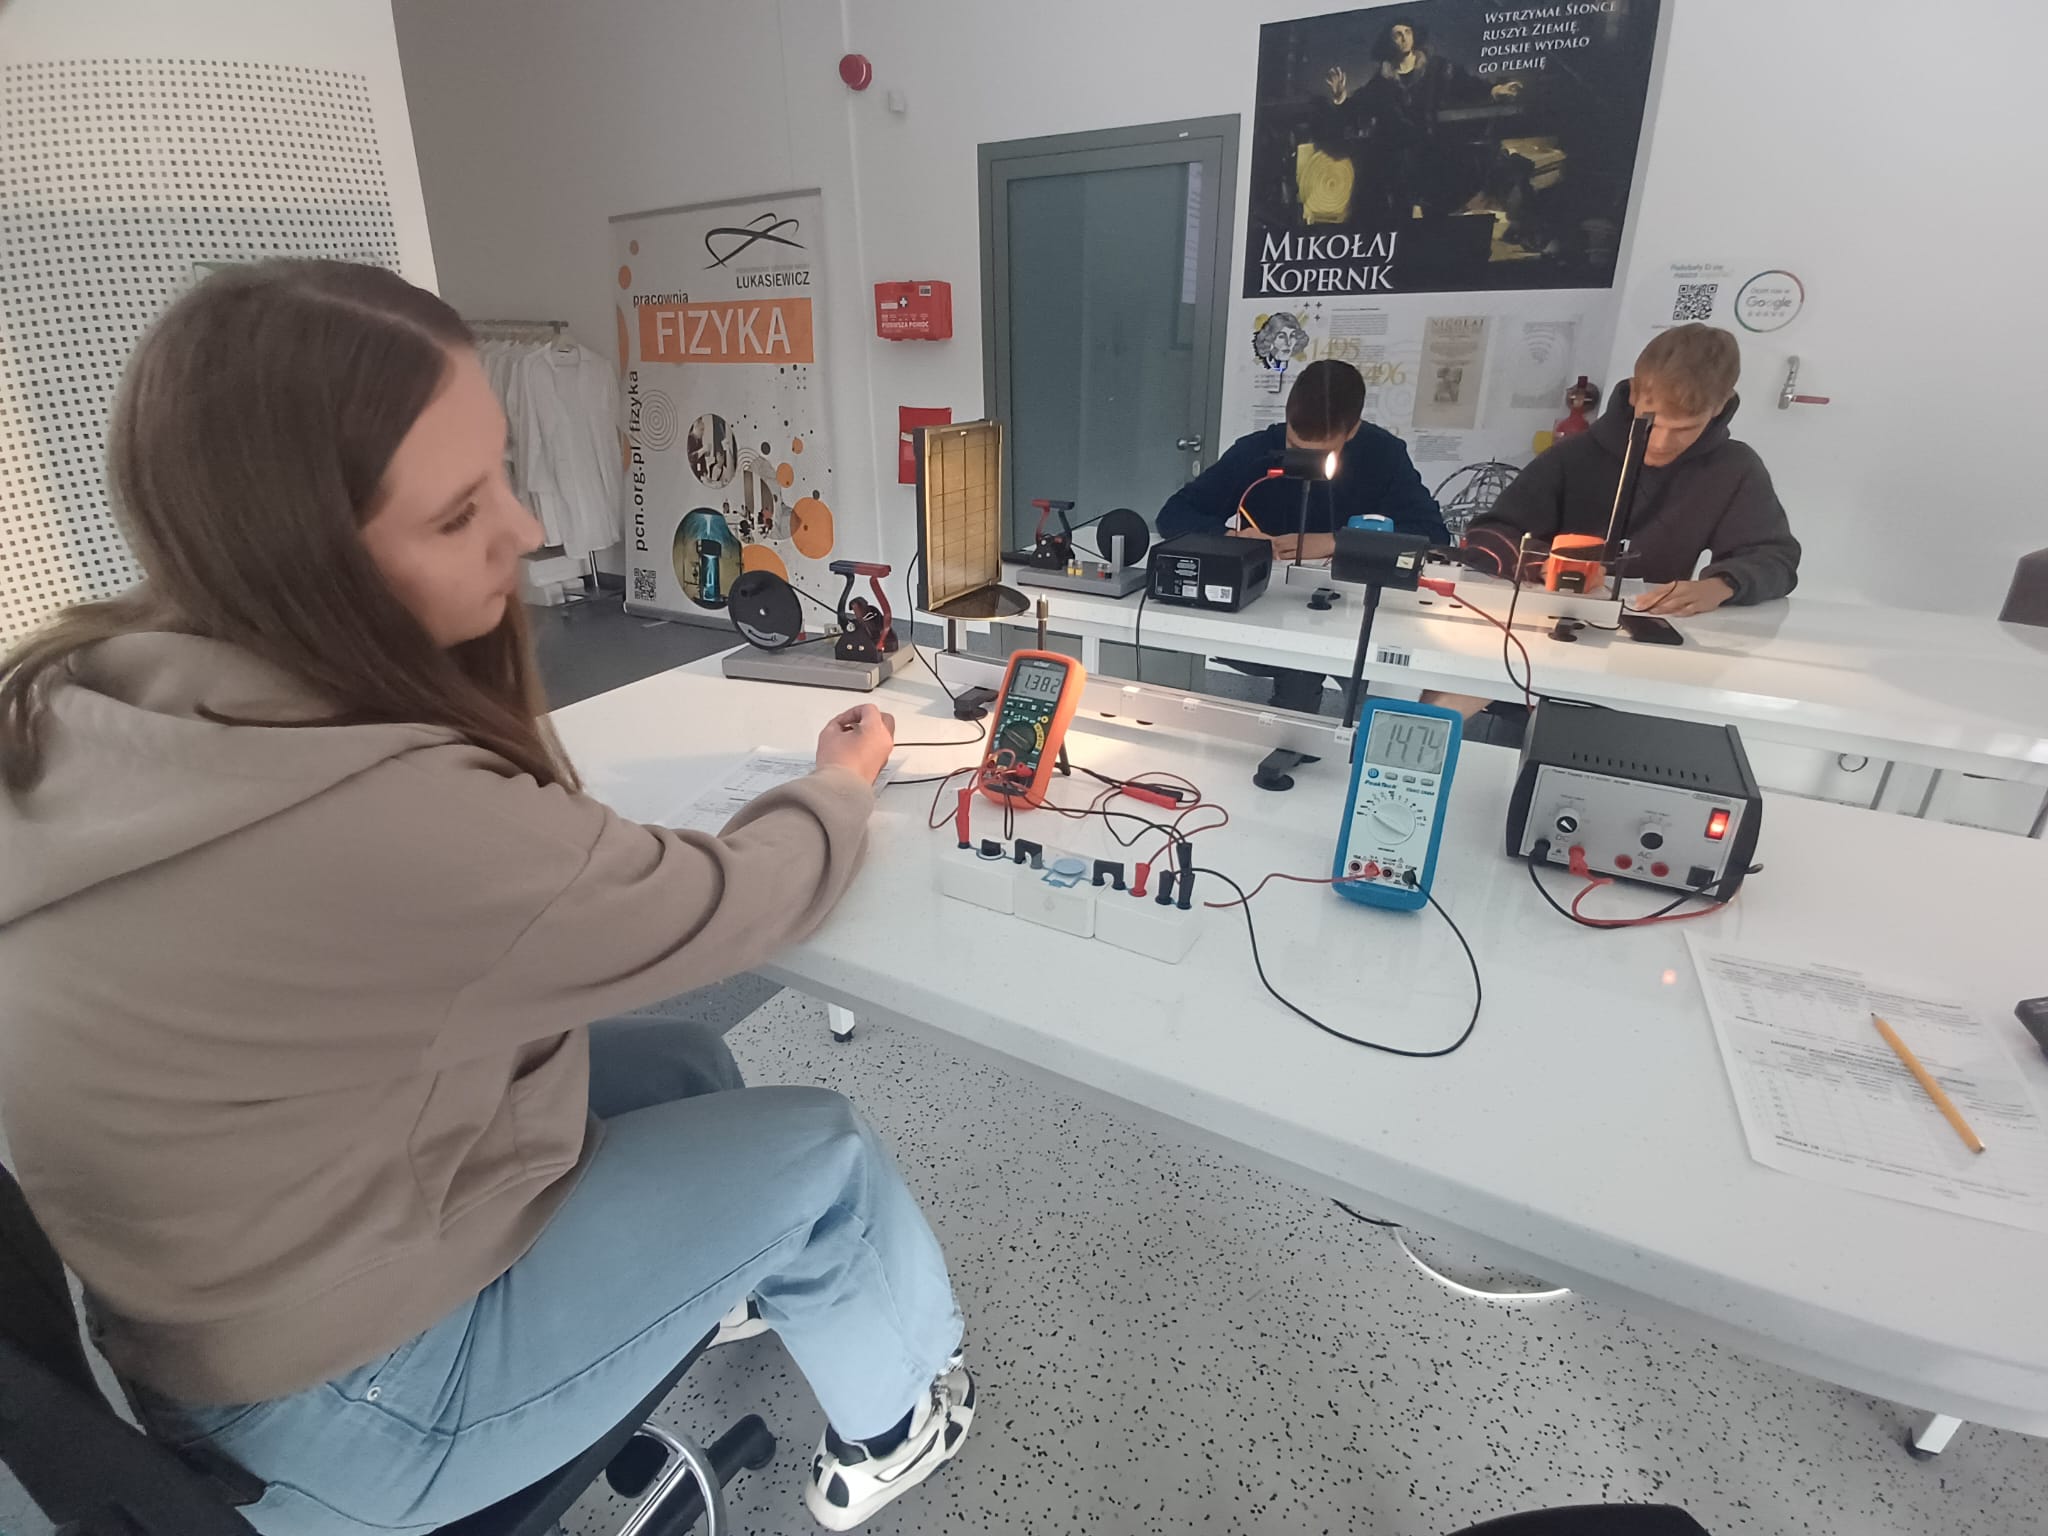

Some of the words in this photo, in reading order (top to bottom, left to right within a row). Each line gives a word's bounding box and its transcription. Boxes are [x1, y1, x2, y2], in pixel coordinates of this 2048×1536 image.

[1481, 42, 1530, 57] POLSKIE
[1478, 62, 1498, 73] GO
[1502, 57, 1547, 70] PLEMIĘ
[1260, 231, 1398, 263] MIKOŁAJ
[1259, 262, 1394, 293] KOPERNIK
[633, 290, 689, 308] pracownia
[1746, 295, 1792, 311] Google
[656, 306, 792, 355] FIZYKA
[1311, 336, 1360, 360] 1495
[628, 371, 649, 552] pcn.org.pl/fizyka
